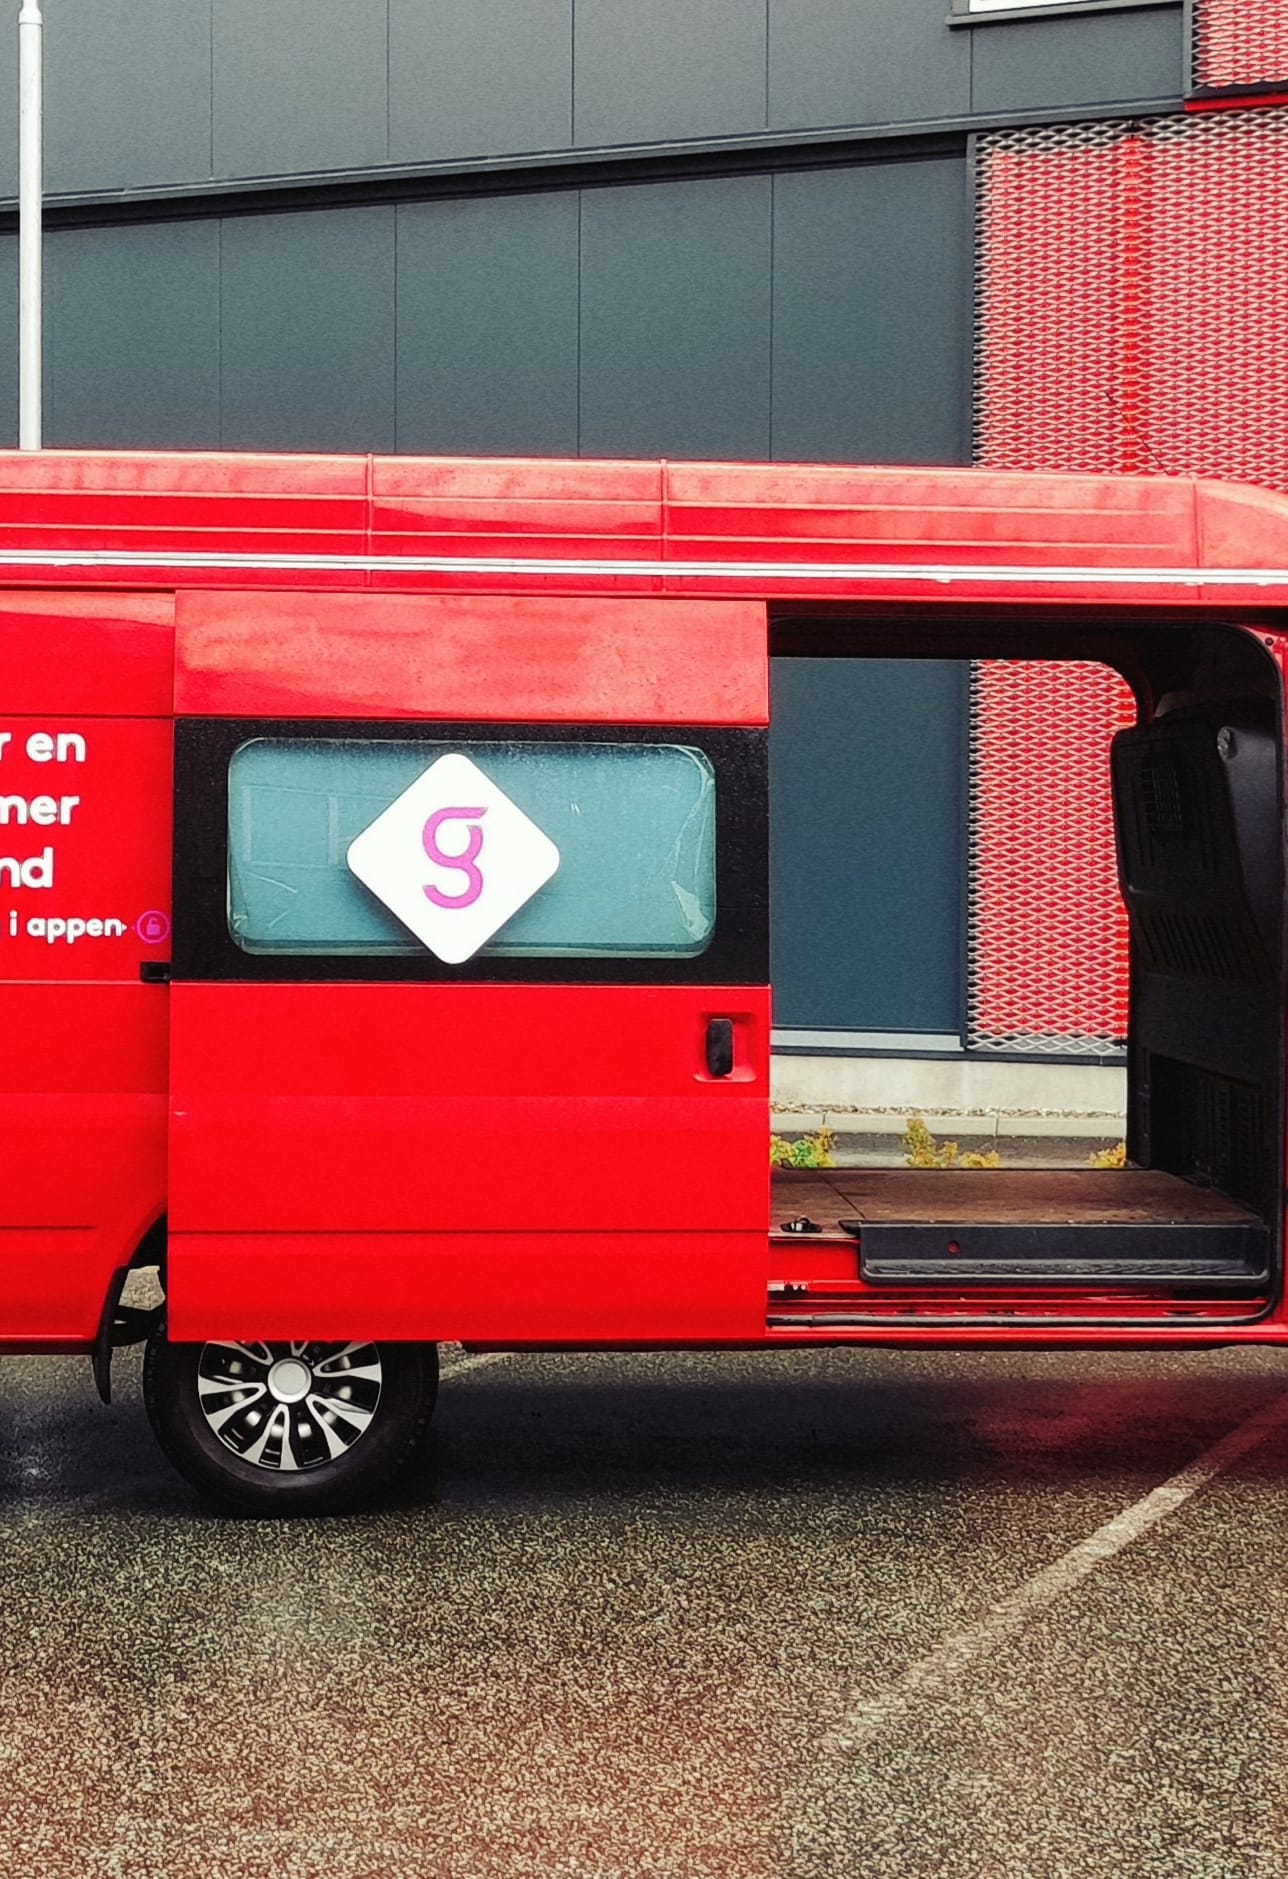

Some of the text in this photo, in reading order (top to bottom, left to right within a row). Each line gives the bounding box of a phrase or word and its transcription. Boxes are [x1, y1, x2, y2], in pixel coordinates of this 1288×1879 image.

[25, 732, 87, 763] en
[422, 806, 488, 910] g
[9, 910, 18, 937] i
